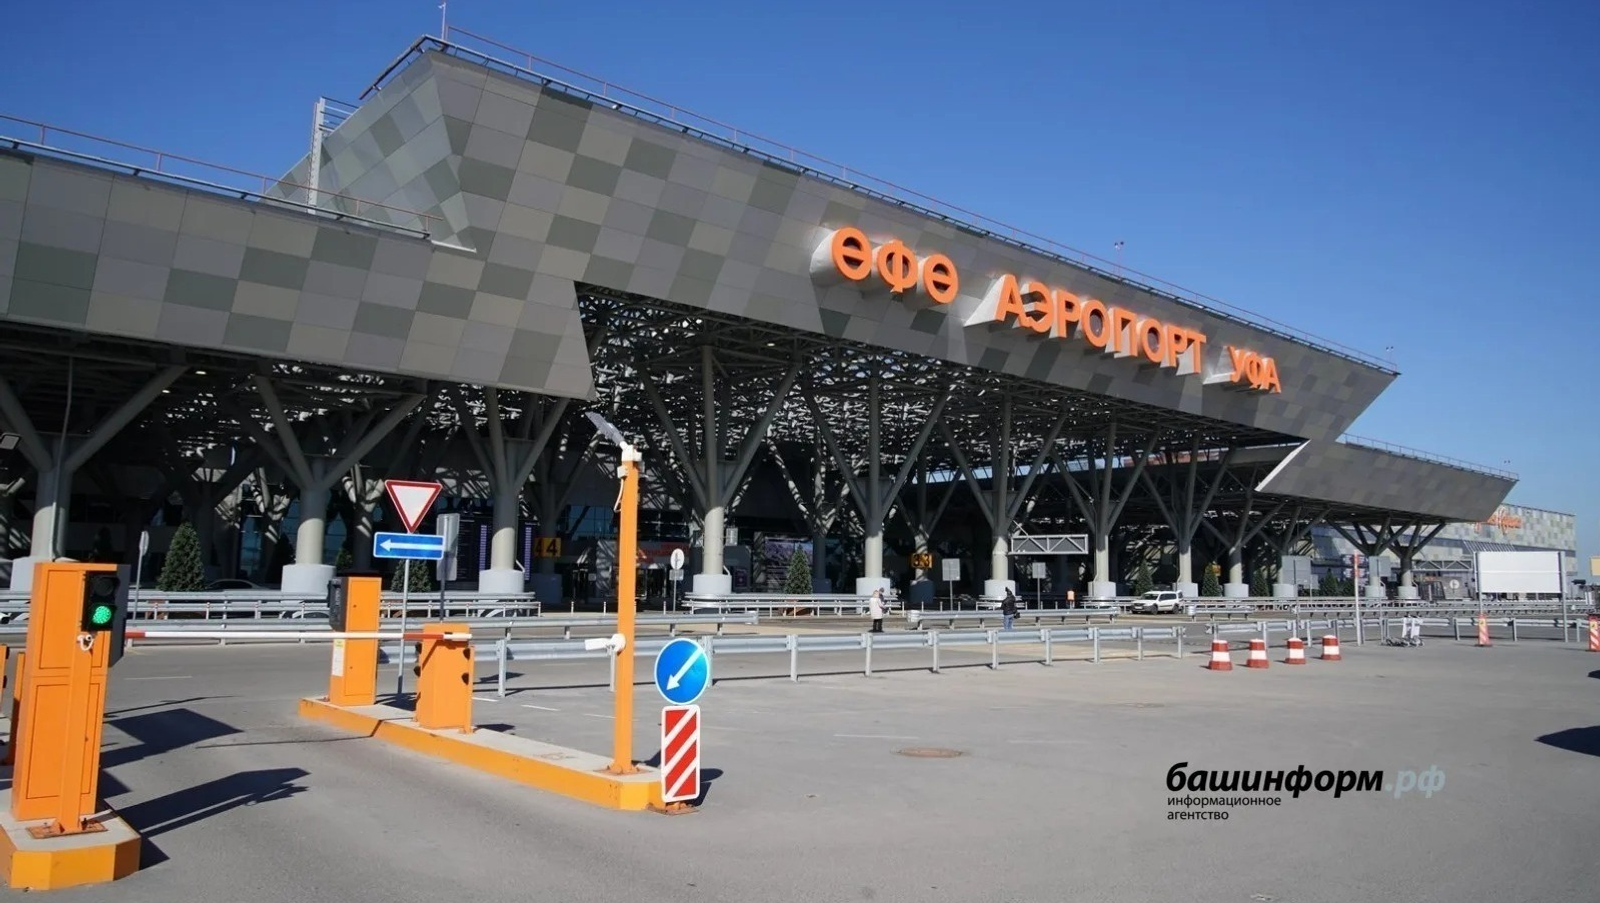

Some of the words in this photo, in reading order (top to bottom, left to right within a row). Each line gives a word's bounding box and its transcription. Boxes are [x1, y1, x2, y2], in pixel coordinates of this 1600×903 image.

[831, 226, 960, 304] ӨФӨ
[996, 274, 1205, 374] АЭРОПОРТ
[1229, 345, 1281, 393] УФА
